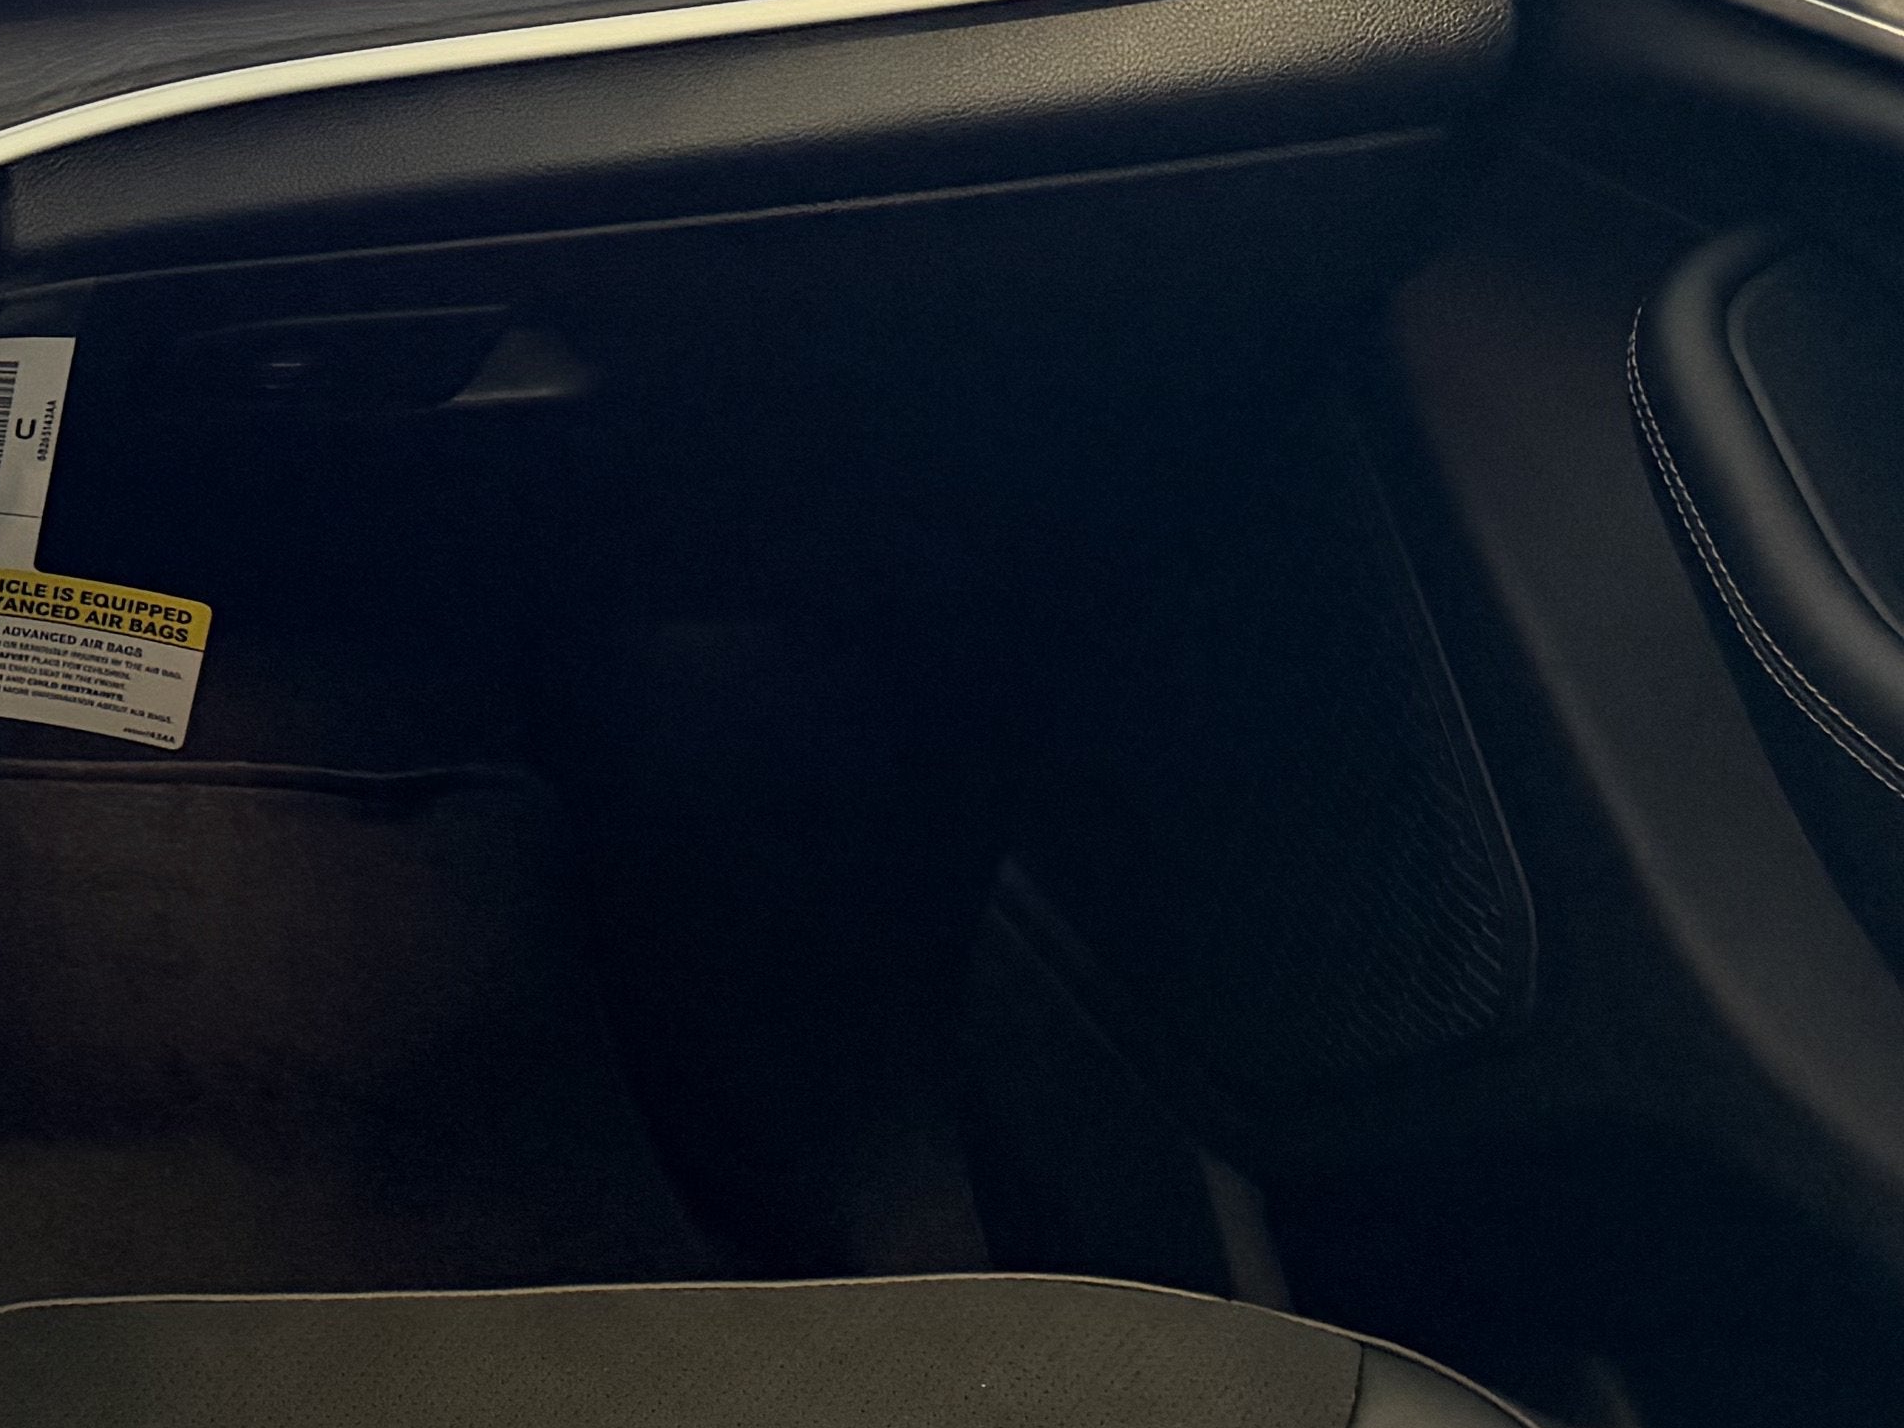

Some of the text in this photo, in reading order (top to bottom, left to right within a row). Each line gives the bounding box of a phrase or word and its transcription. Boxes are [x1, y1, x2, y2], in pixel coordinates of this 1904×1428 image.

[14, 418, 37, 440] U
[52, 586, 74, 602] IS
[79, 590, 192, 625] EQUIPPED
[2, 625, 77, 645] ADVANCED
[80, 637, 103, 651] AIR
[106, 641, 143, 658] BAGS
[84, 610, 124, 629] AIR
[129, 618, 189, 643] BAGS
